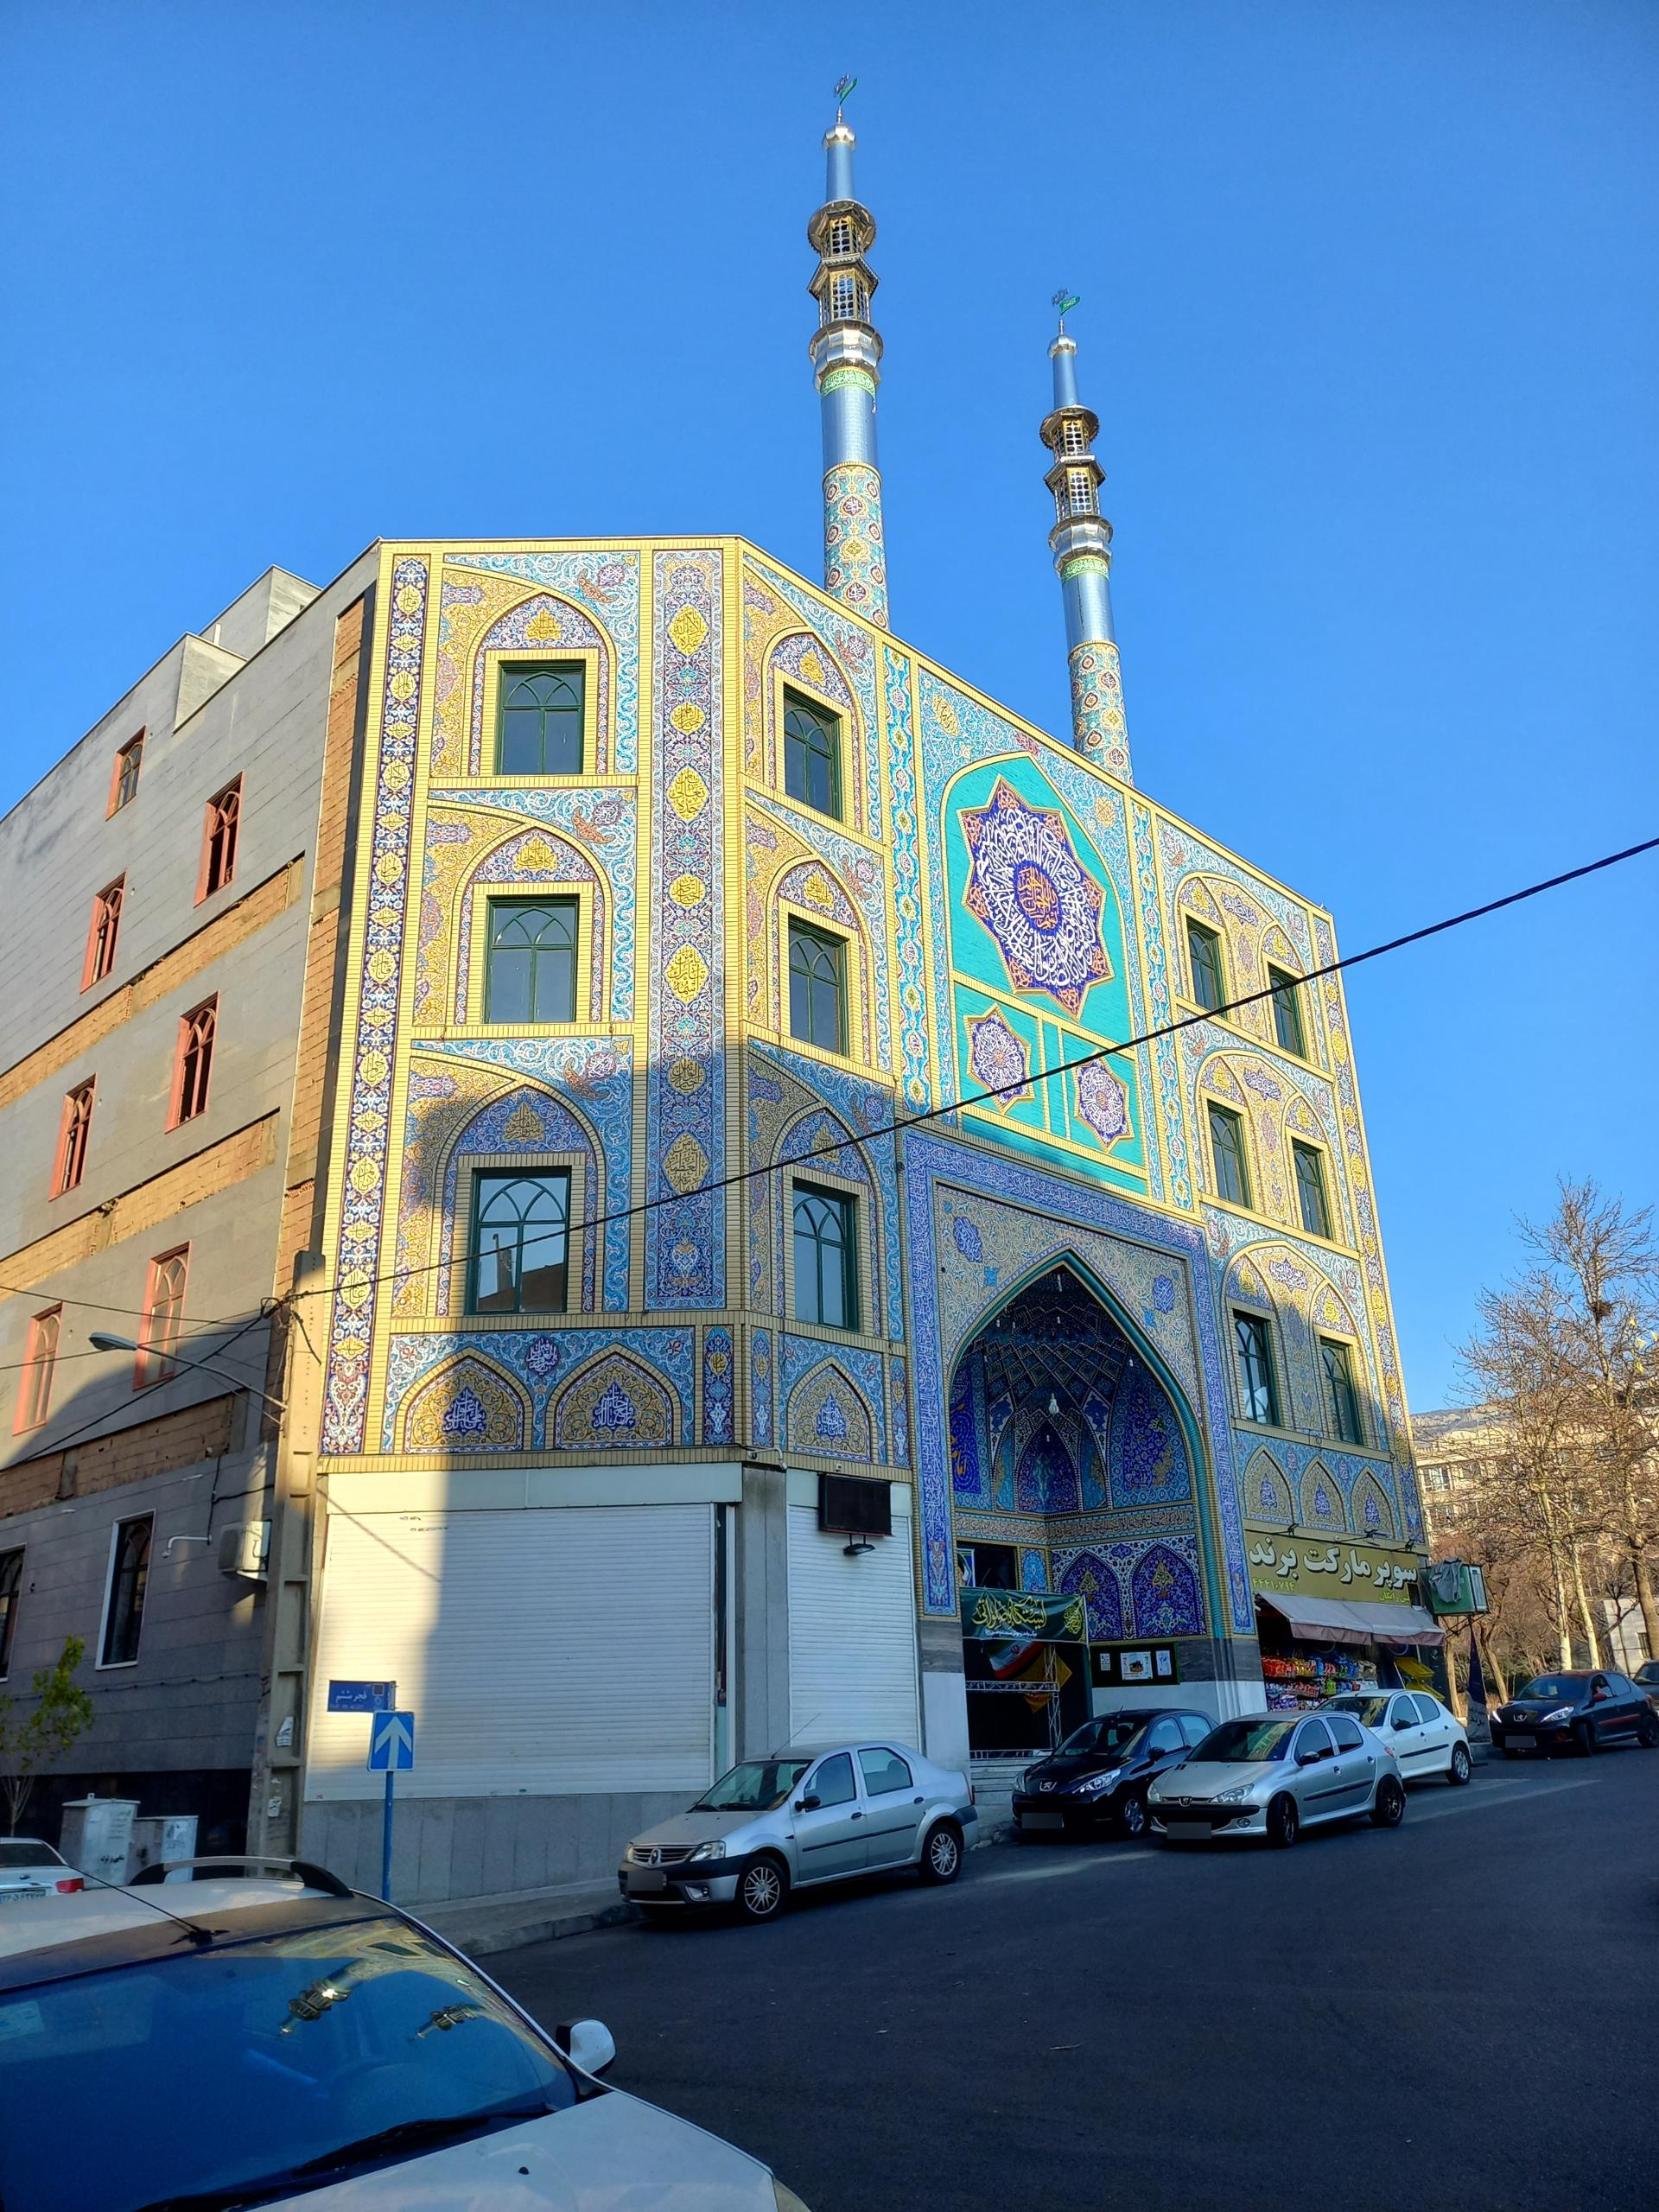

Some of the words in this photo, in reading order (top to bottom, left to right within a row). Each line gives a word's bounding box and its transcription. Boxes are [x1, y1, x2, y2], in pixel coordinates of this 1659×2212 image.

[1249, 1536, 1299, 1580] برند
[1303, 1548, 1372, 1584] مارکت
[1373, 1560, 1418, 1589] سوپر
